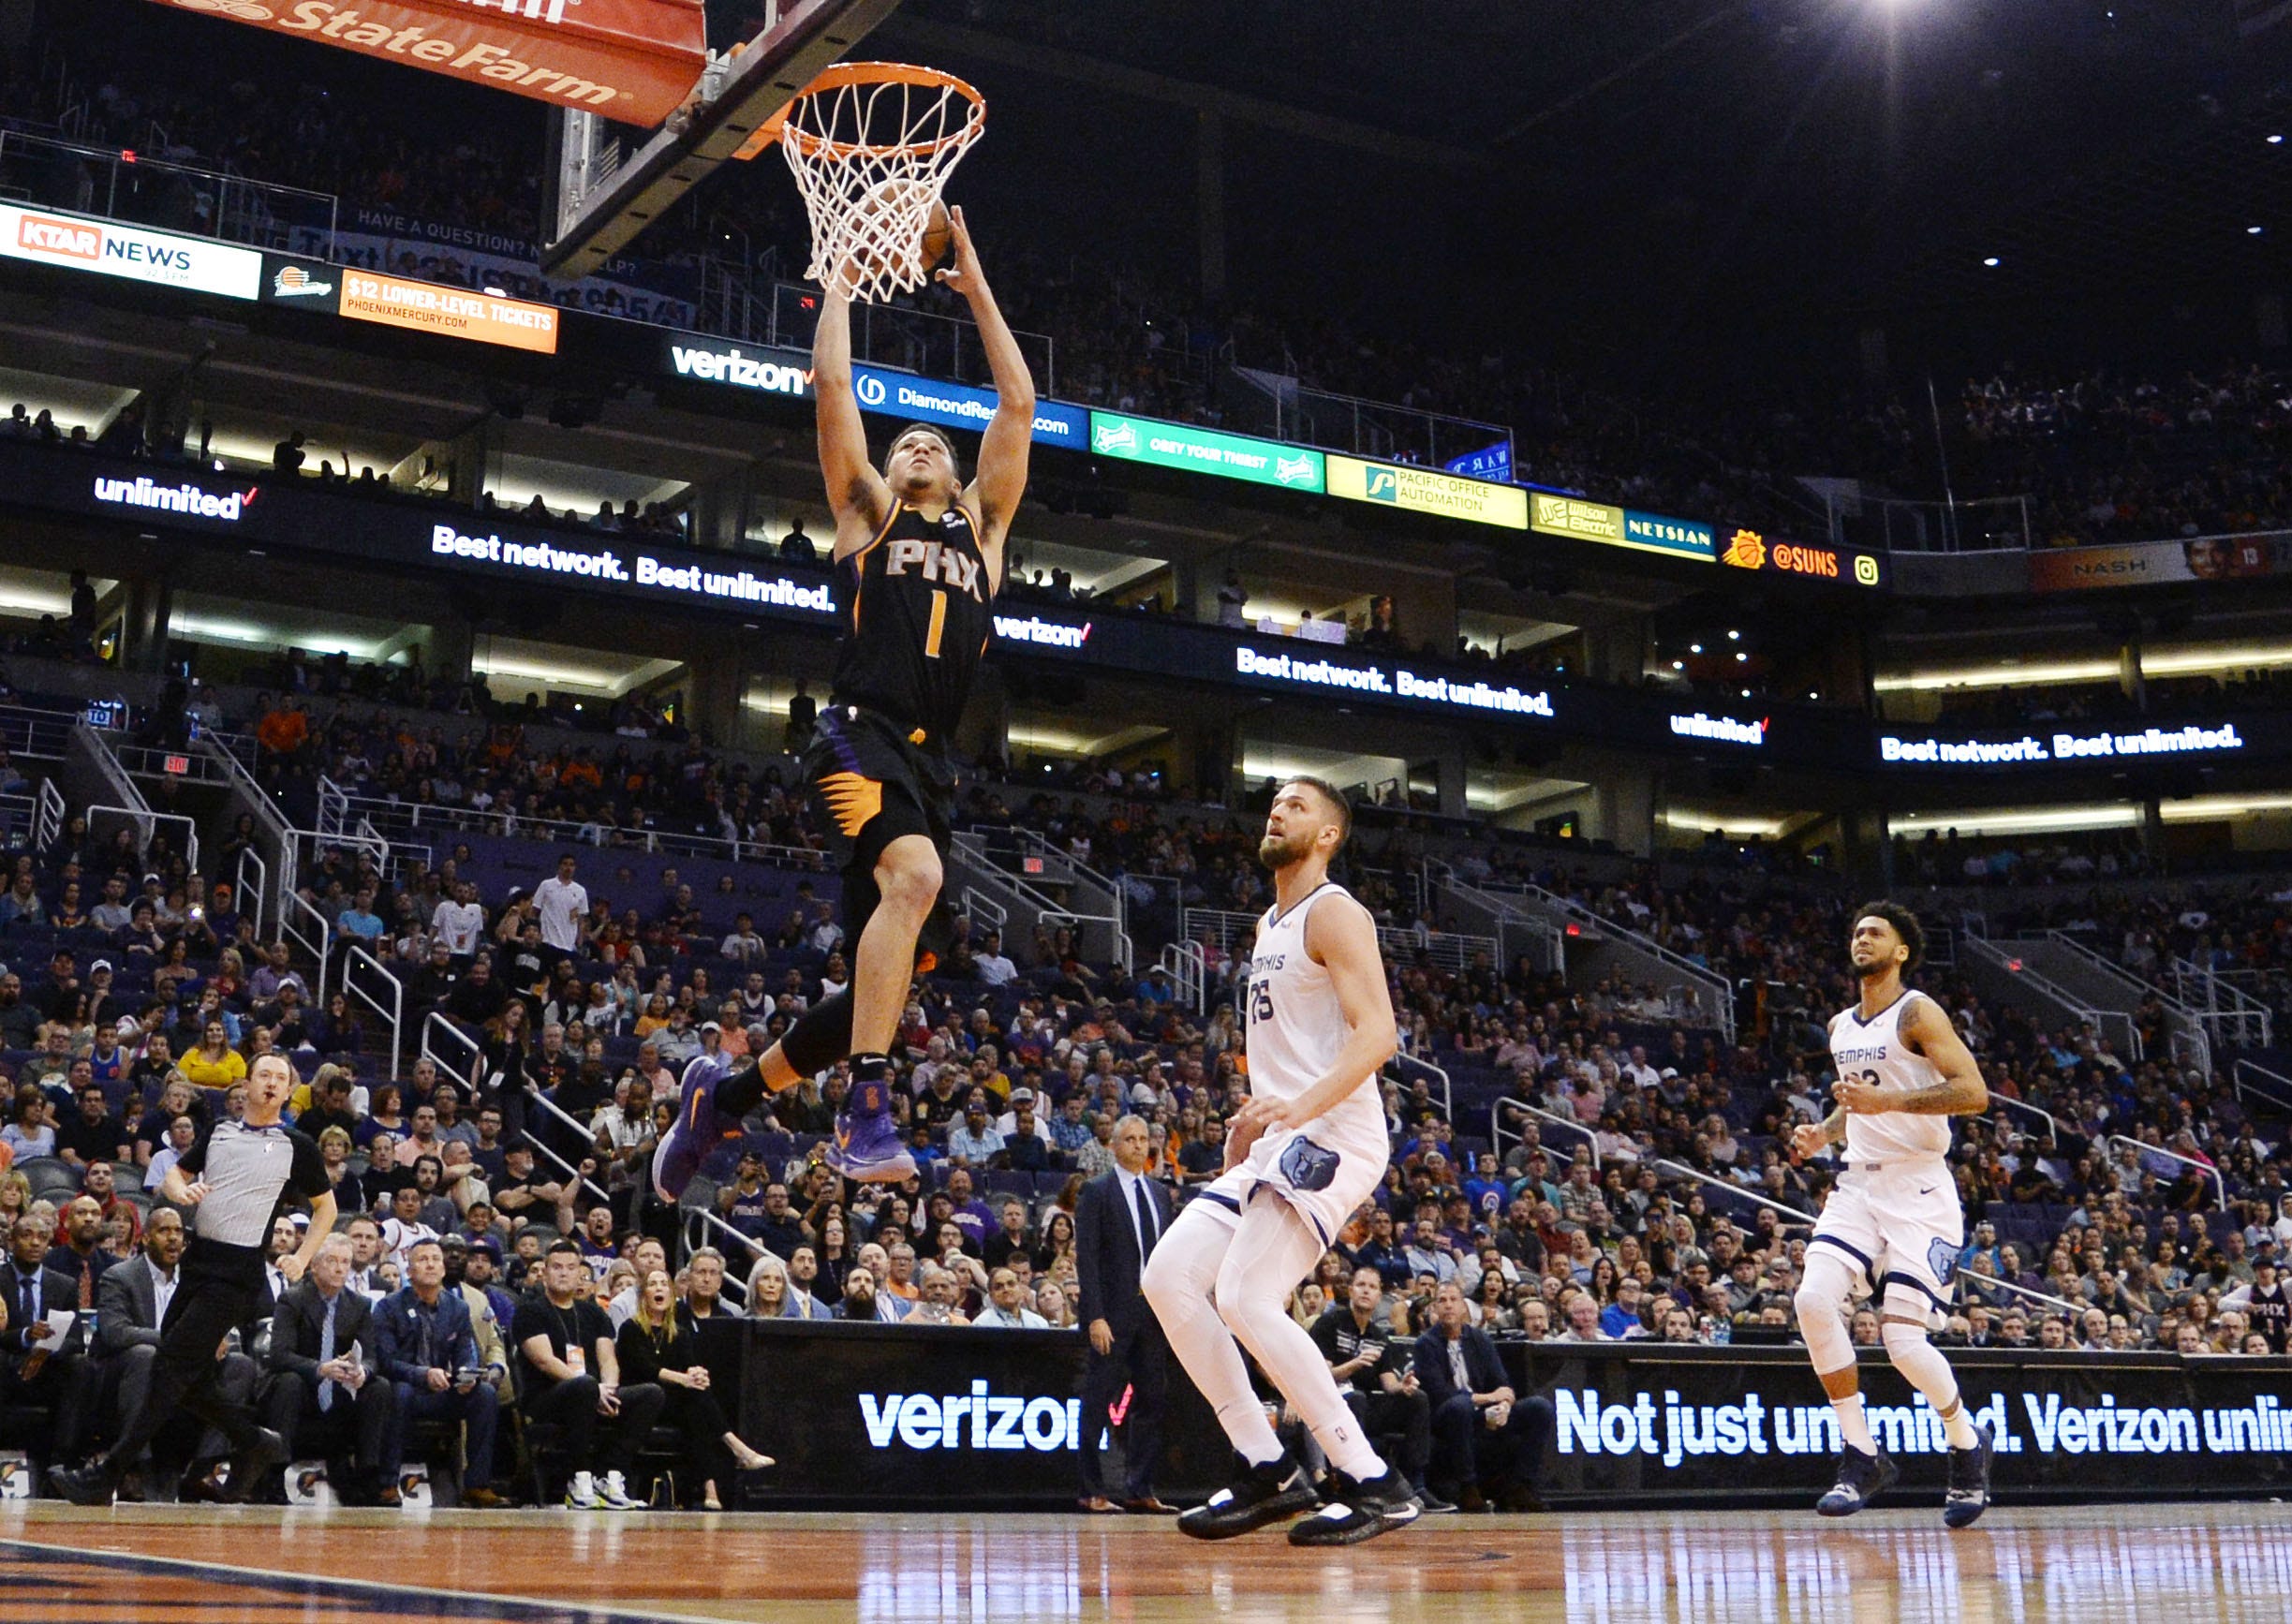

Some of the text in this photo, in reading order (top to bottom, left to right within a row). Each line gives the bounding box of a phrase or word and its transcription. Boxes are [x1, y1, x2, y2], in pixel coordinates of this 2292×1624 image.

[22, 221, 191, 270] KTAR NEWS
[408, 224, 421, 234] A
[425, 224, 525, 256] QUESTION?
[347, 277, 377, 302] $12
[381, 283, 486, 319] LOWER-LEVEL
[490, 302, 553, 331] TICKETS
[347, 298, 468, 329] PHOENIXMERCURY.COM
[672, 346, 805, 394] verizon
[897, 387, 1069, 436] DiamondRes.com
[1150, 437, 1268, 468] OBEY YOUR THIRST
[96, 476, 240, 520] unlimited
[1399, 471, 1490, 498] PACIFIC OFFICE
[1399, 487, 1483, 511] AUTOMATION
[1568, 502, 1608, 522] Wilson
[1569, 516, 1617, 537] Electric
[433, 525, 835, 613] Best network. Best unlimited.
[886, 539, 983, 603] PHX
[1773, 543, 1839, 578] @SUNS
[2074, 560, 2146, 576] NASH
[924, 589, 947, 658] 1
[993, 615, 1081, 648] verizon
[1237, 647, 1554, 717] Best network. Best unlimited.
[1670, 713, 1762, 745] unlimited
[1882, 725, 2242, 762] Best network. Best unlimited.
[1555, 1389, 1659, 1454] Not
[1664, 1390, 1768, 1468] just
[2022, 1394, 2200, 1454] Verizon
